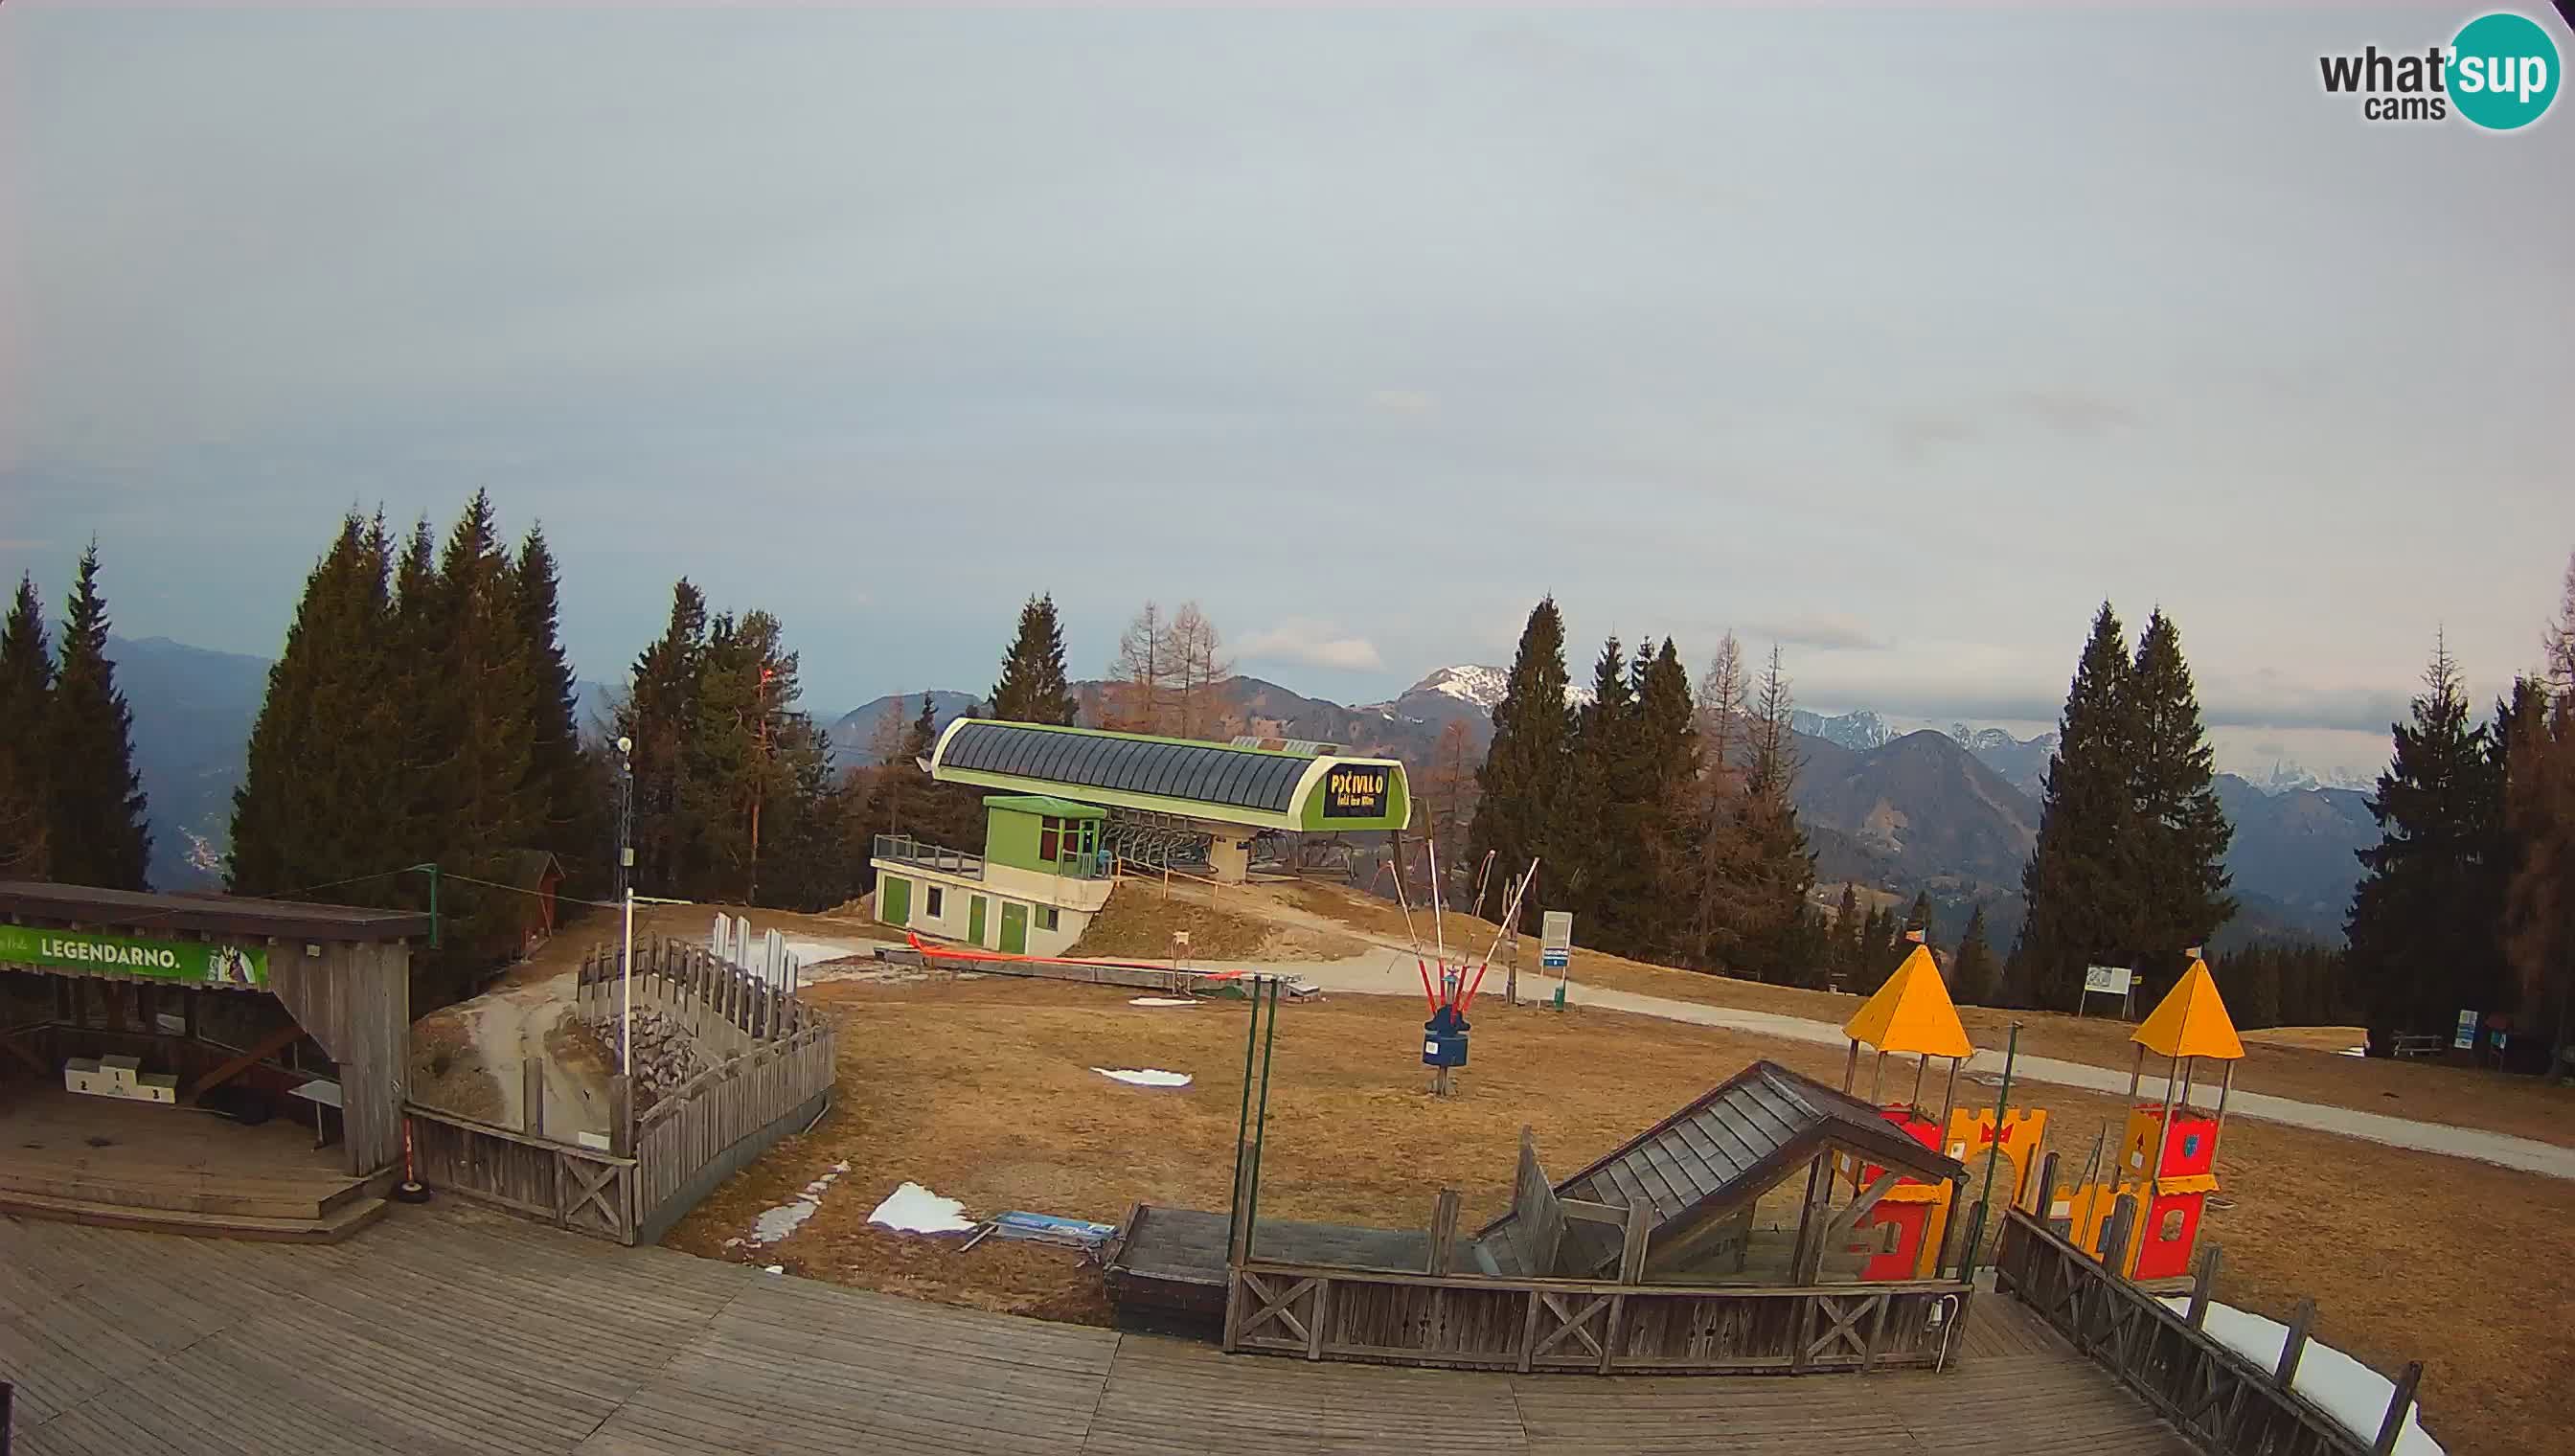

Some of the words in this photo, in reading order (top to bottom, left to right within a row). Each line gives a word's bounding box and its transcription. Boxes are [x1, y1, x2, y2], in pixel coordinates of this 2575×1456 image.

[41, 938, 181, 968] LEGENDARNO.
[80, 1081, 87, 1090] 2
[152, 1089, 160, 1099] 3
